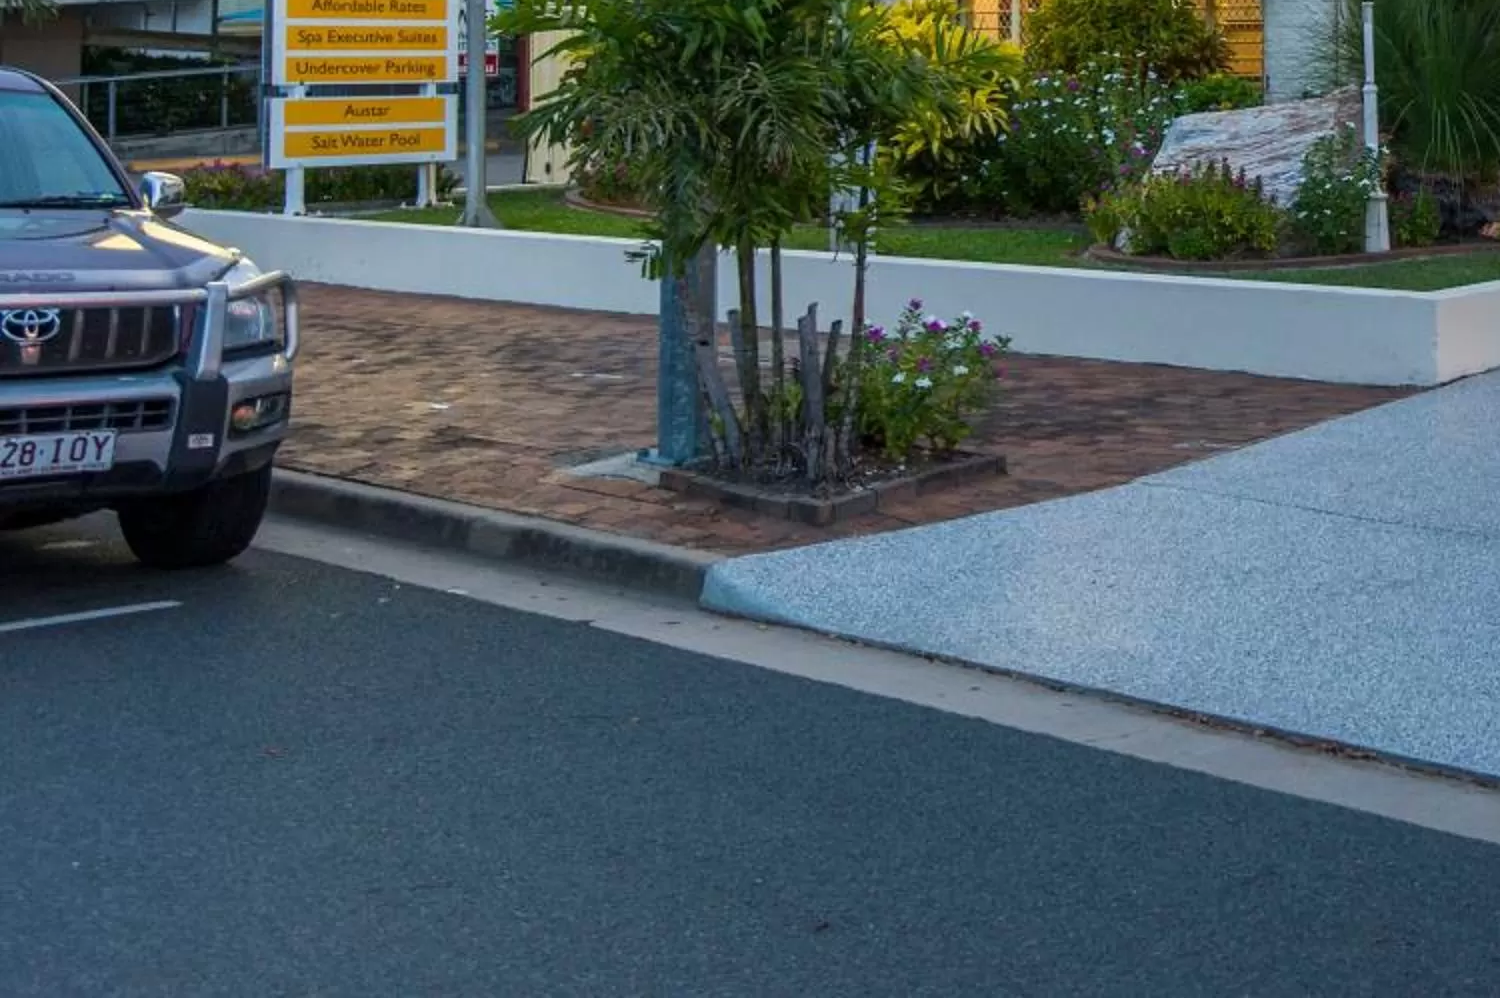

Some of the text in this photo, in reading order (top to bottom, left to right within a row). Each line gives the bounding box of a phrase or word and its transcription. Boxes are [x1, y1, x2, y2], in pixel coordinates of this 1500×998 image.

[389, 0, 426, 13] Rates
[297, 30, 437, 46] Spa Executive Suites
[295, 60, 436, 76] Undercover Parking
[344, 105, 391, 118] Austar
[311, 133, 421, 150] Salt Water Pool
